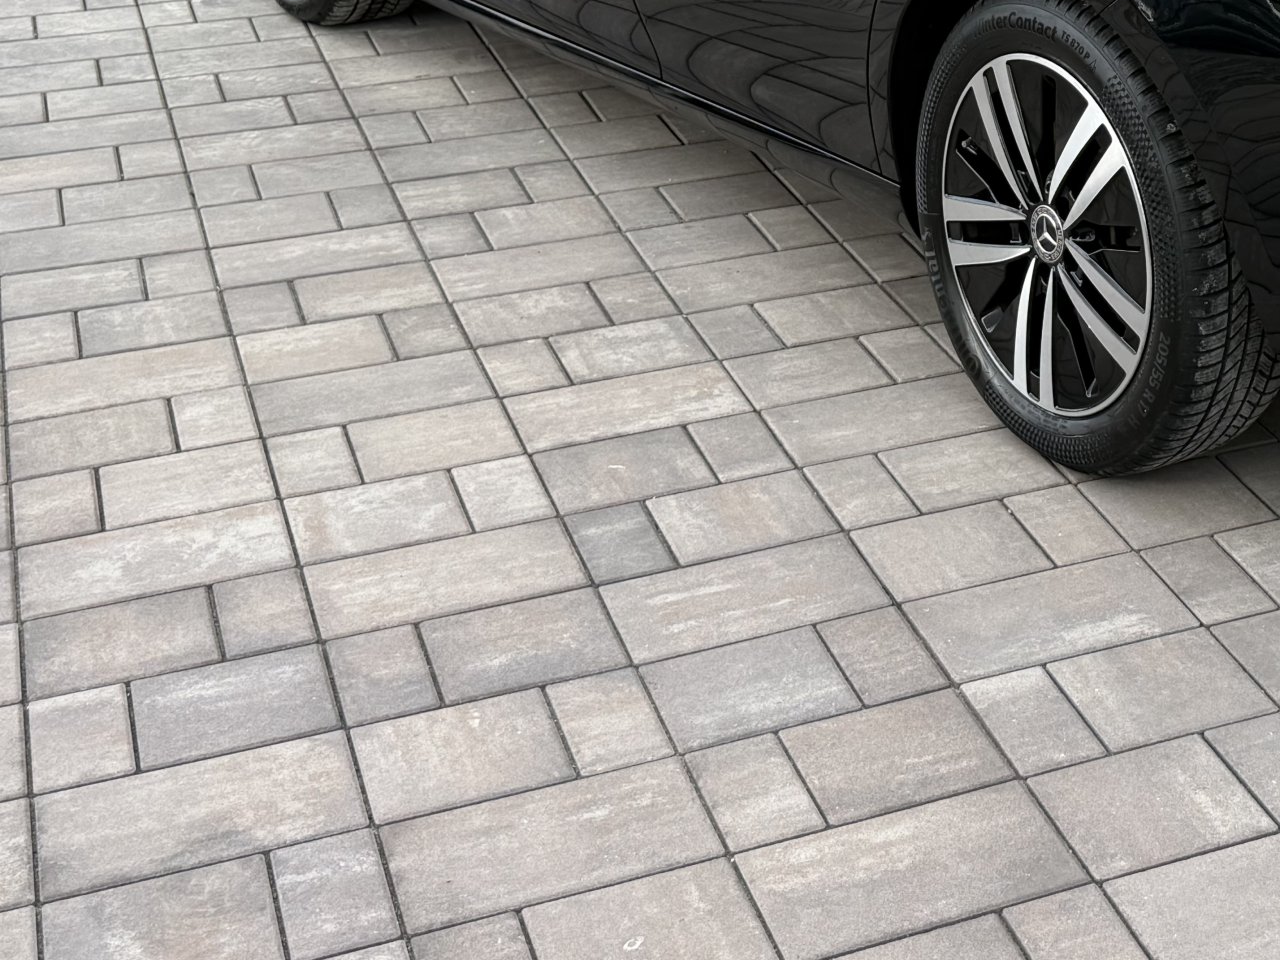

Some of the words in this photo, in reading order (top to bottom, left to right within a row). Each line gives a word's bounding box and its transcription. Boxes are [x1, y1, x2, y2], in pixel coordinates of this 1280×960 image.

[1061, 30, 1071, 43] TS
[1070, 38, 1085, 56] 870
[1148, 331, 1171, 390] 205/55
[1142, 387, 1156, 404] R
